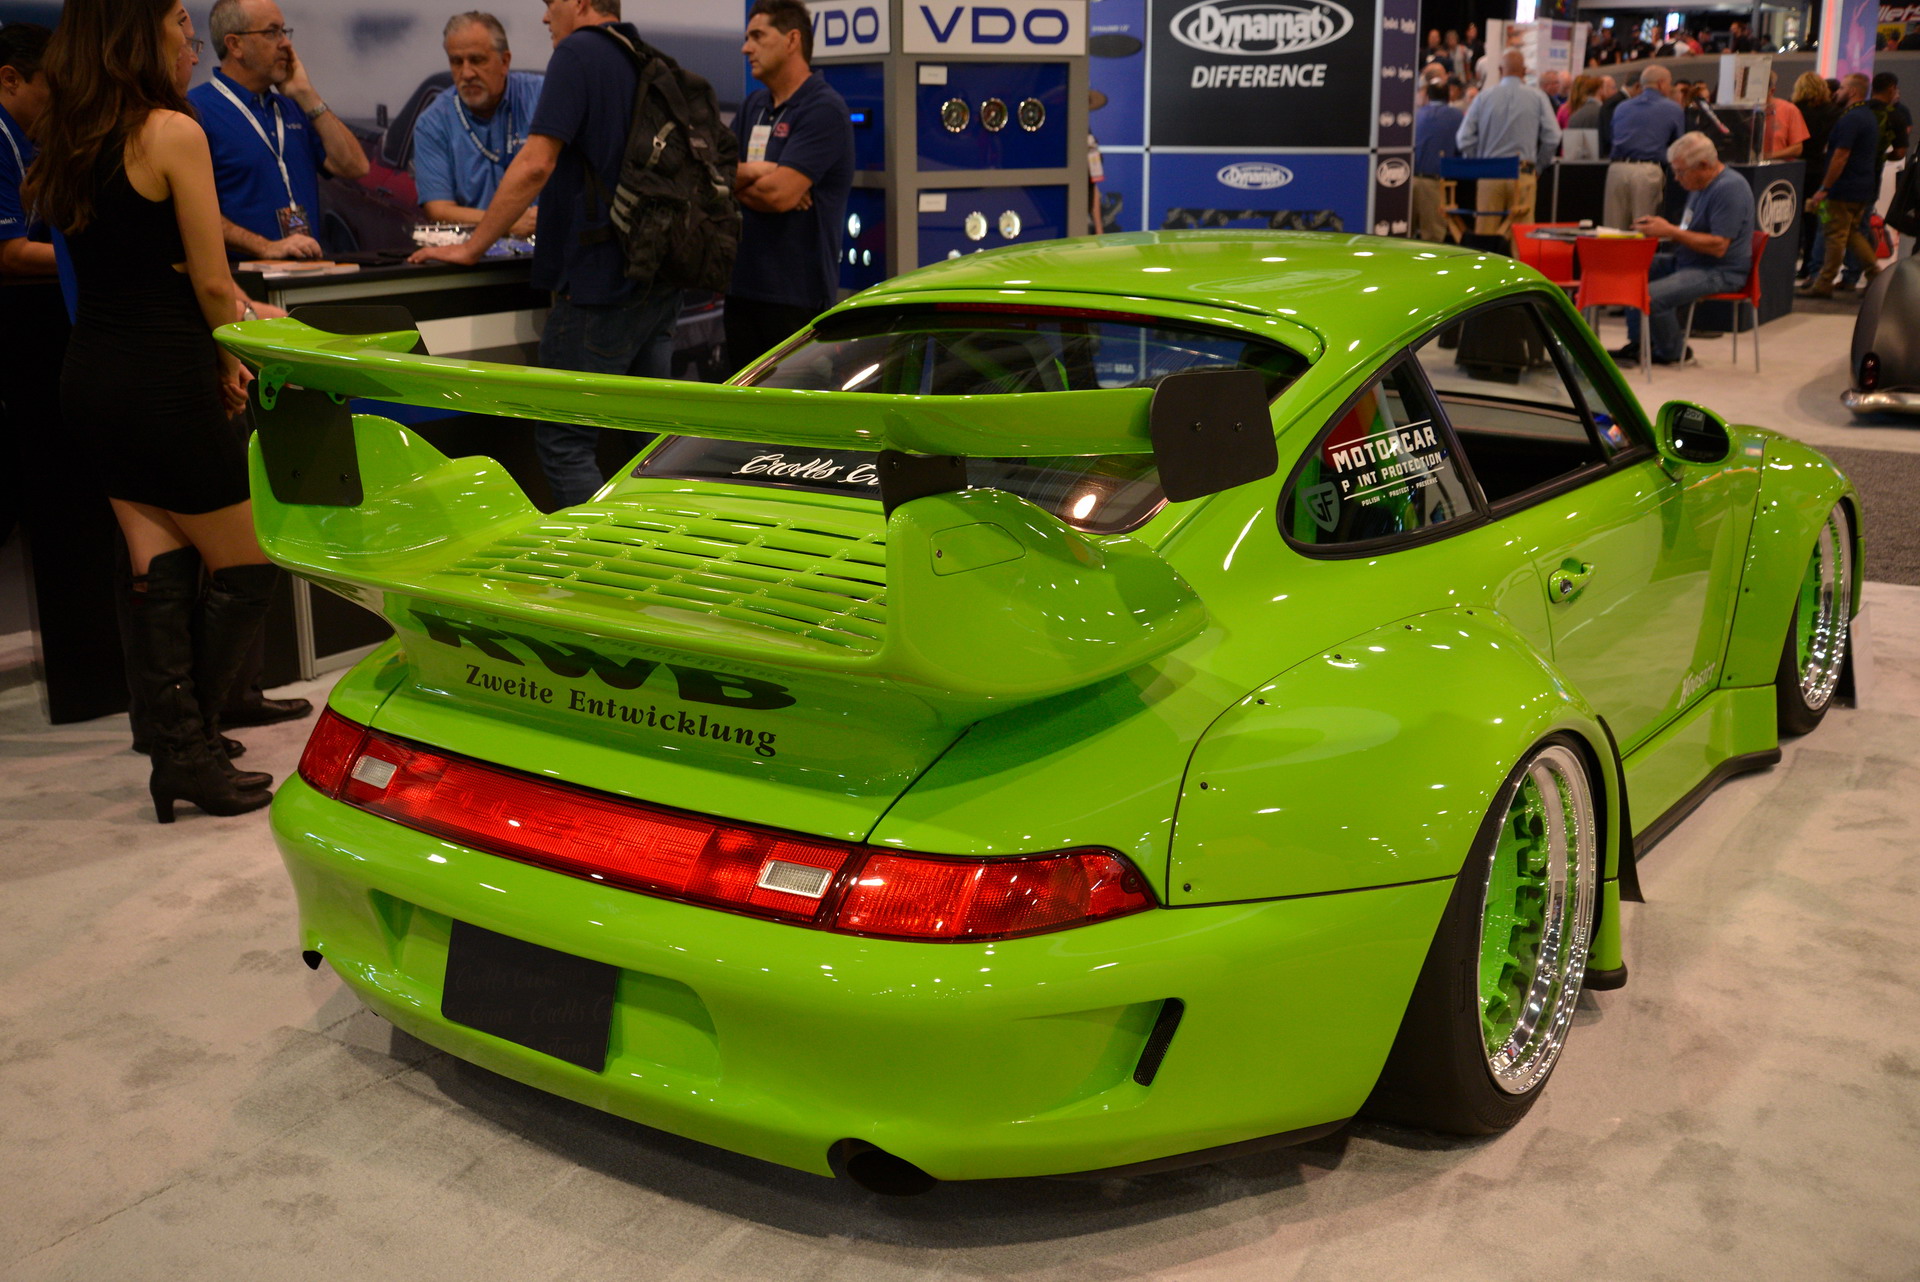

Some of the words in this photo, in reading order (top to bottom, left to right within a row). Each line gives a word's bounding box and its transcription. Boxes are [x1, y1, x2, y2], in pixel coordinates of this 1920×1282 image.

[919, 5, 1069, 45] VDO
[1200, 5, 1323, 49] Dynamat
[1191, 64, 1327, 88] DIFFERENCE
[1229, 165, 1281, 185] Dynamat
[1332, 426, 1437, 473] MOTORCAR
[1381, 450, 1442, 481] PROTECTION
[1361, 495, 1381, 507] POLISH
[1389, 486, 1410, 498] PROTECT
[1416, 476, 1439, 489] PRESERVE
[407, 609, 797, 710] RWB
[465, 663, 553, 704] Zweite
[568, 688, 777, 757] Entwicklung
